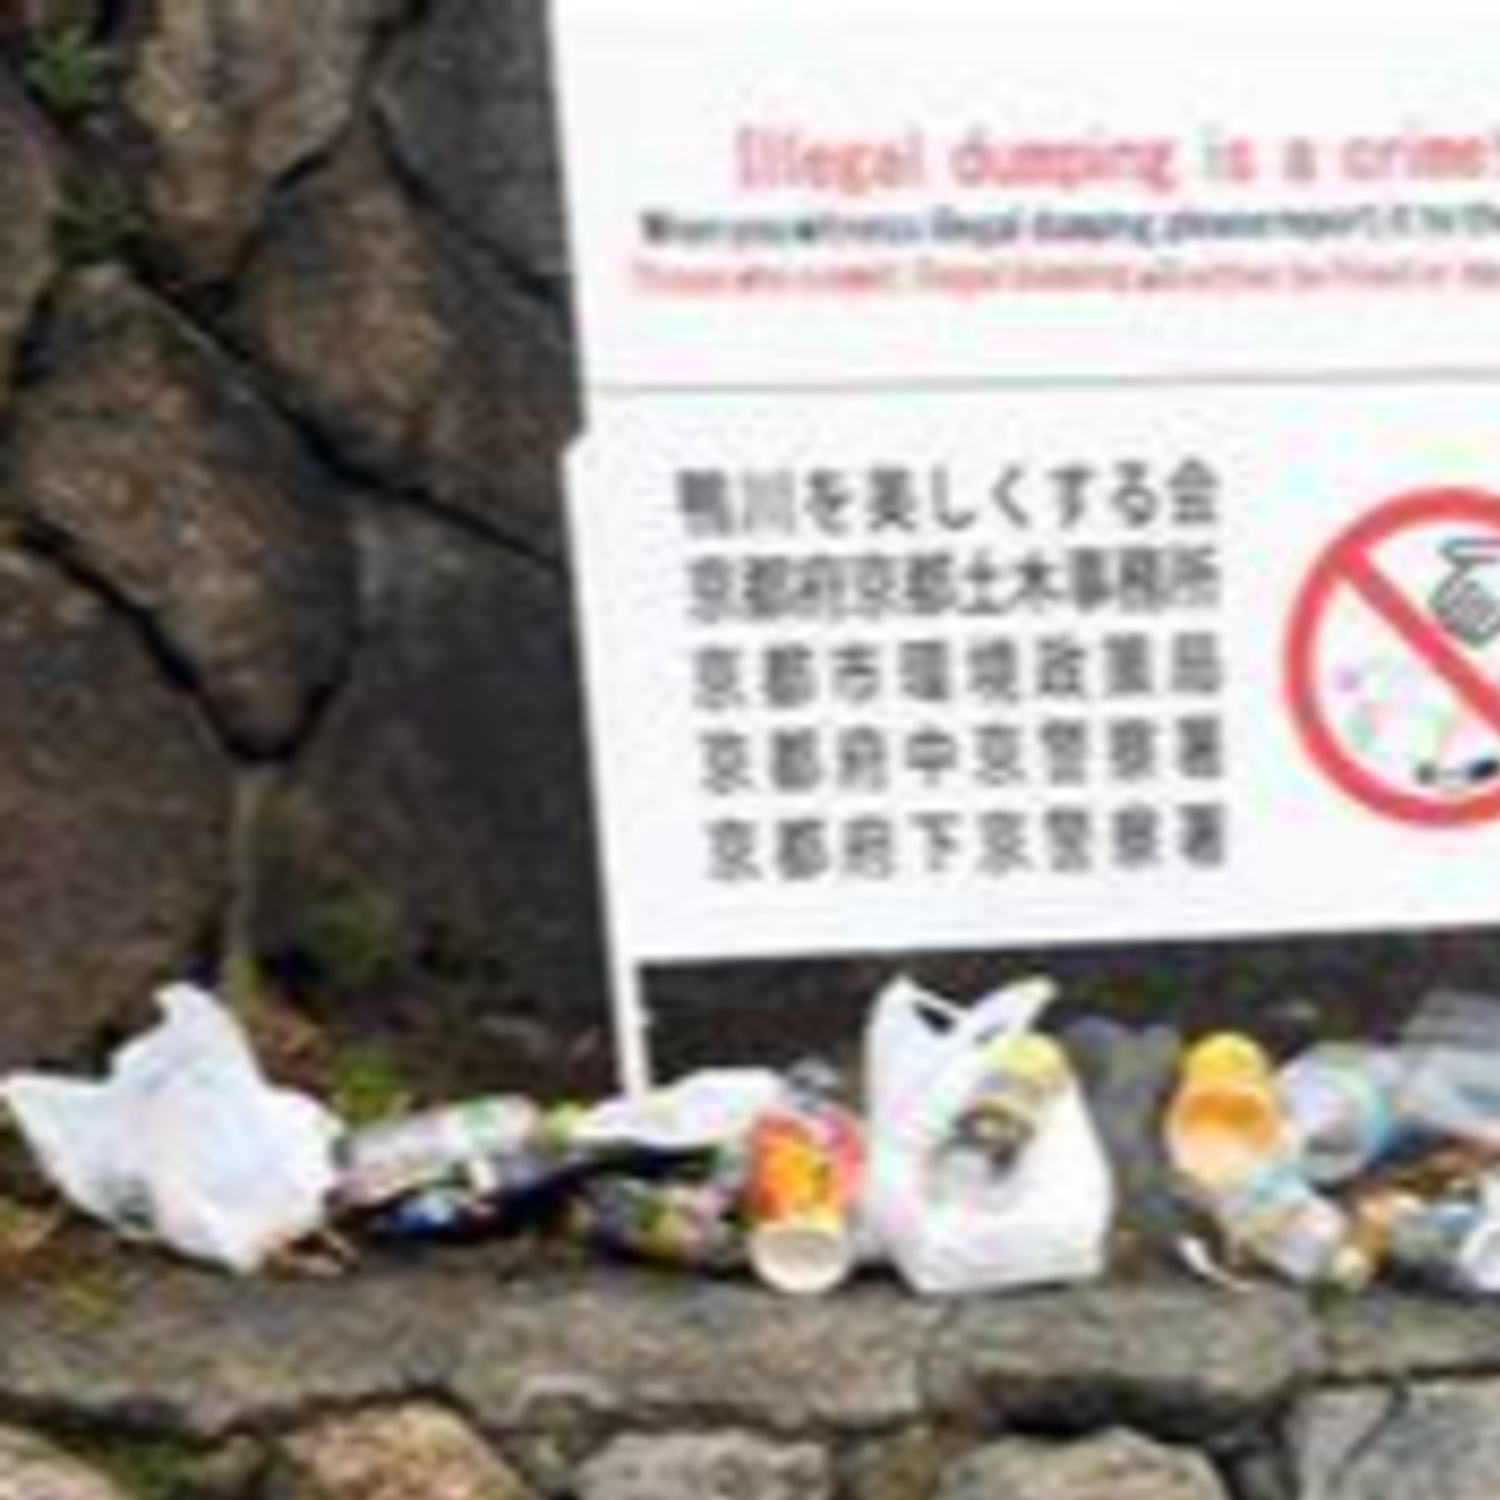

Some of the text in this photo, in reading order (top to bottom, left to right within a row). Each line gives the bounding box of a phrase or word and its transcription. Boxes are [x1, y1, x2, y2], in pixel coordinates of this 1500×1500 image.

[738, 128, 923, 193] Illegal
[949, 126, 1176, 191] dumping
[1201, 126, 1254, 180] is
[1281, 138, 1315, 177] a
